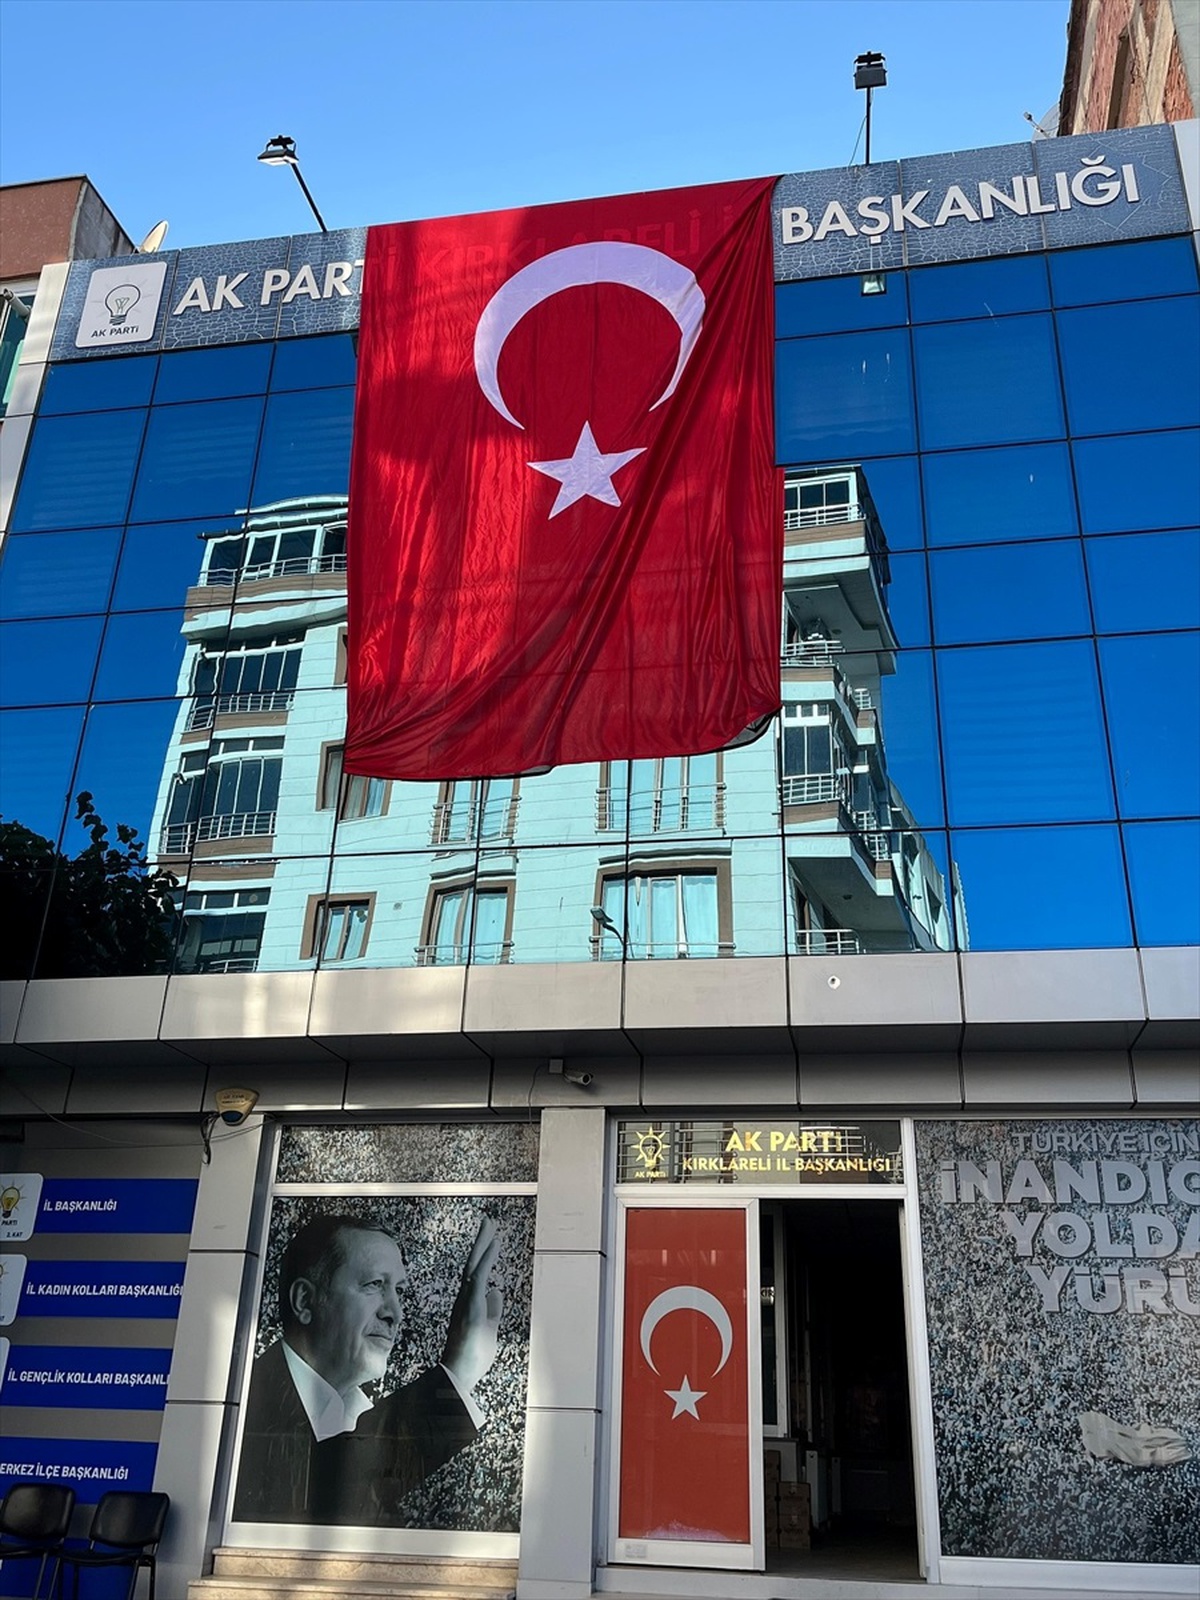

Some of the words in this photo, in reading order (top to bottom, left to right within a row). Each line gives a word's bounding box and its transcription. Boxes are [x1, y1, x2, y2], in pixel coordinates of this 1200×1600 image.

[172, 272, 250, 316] AK
[782, 154, 1140, 244] BAŞKANLIĞI
[91, 328, 107, 338] AK
[725, 1131, 763, 1152] AK
[682, 1153, 771, 1171] KIRKLARELİ
[776, 1153, 791, 1171] İL
[795, 1154, 890, 1176] BAŞKANLIĞI
[43, 1199, 53, 1212] İL
[55, 1199, 117, 1213] BAŞKANLIĞI
[26, 1282, 36, 1295] İL
[38, 1284, 71, 1296] KADIN
[72, 1284, 118, 1297] KOLLARI
[8, 1368, 18, 1382] İL
[20, 1369, 65, 1385] GENÇLİK
[66, 1372, 113, 1384] KOLLARI
[35, 1461, 60, 1480] İLÇE
[61, 1465, 129, 1481] BAŞKANLIĞI
